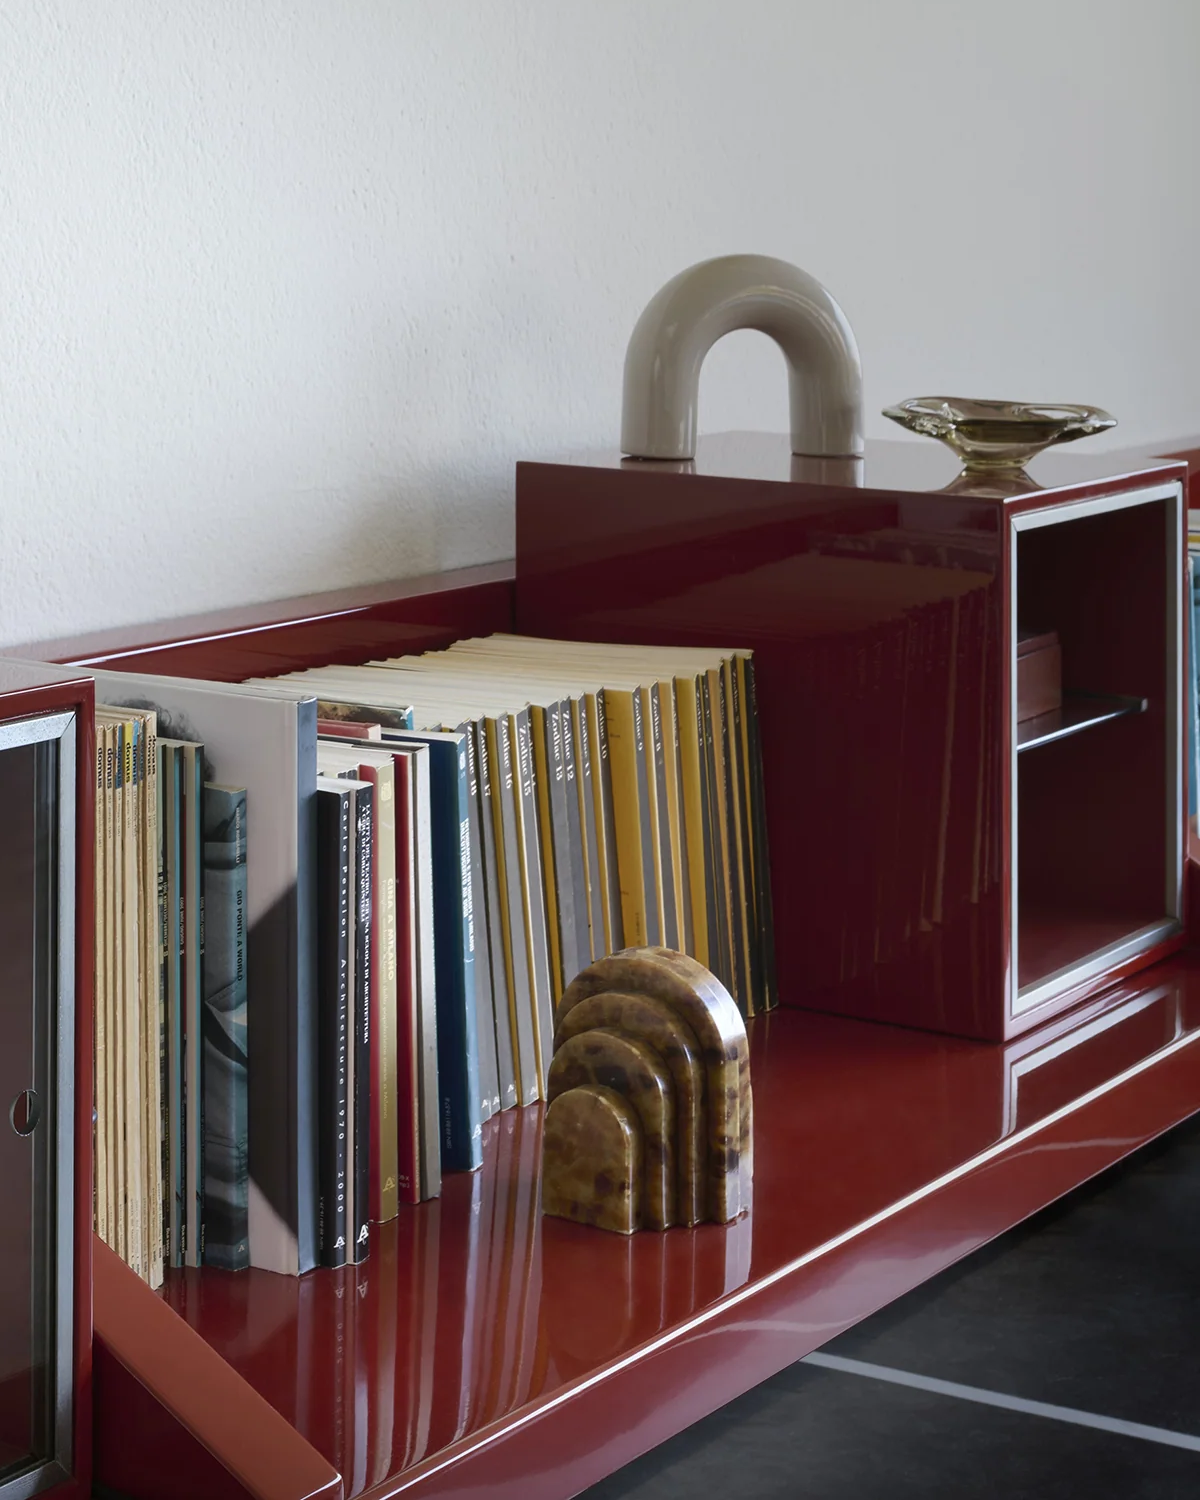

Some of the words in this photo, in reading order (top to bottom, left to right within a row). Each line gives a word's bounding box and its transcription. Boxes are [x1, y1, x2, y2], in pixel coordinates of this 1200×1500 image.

[501, 718, 510, 768] Zodiac
[519, 725, 528, 775] Zodiac
[551, 710, 560, 761] Zodiac
[563, 710, 571, 760] Zodiac
[340, 866, 348, 938] Pession
[236, 949, 244, 981] WORLD
[387, 929, 395, 981] MILANO
[338, 959, 347, 1085] Architecture
